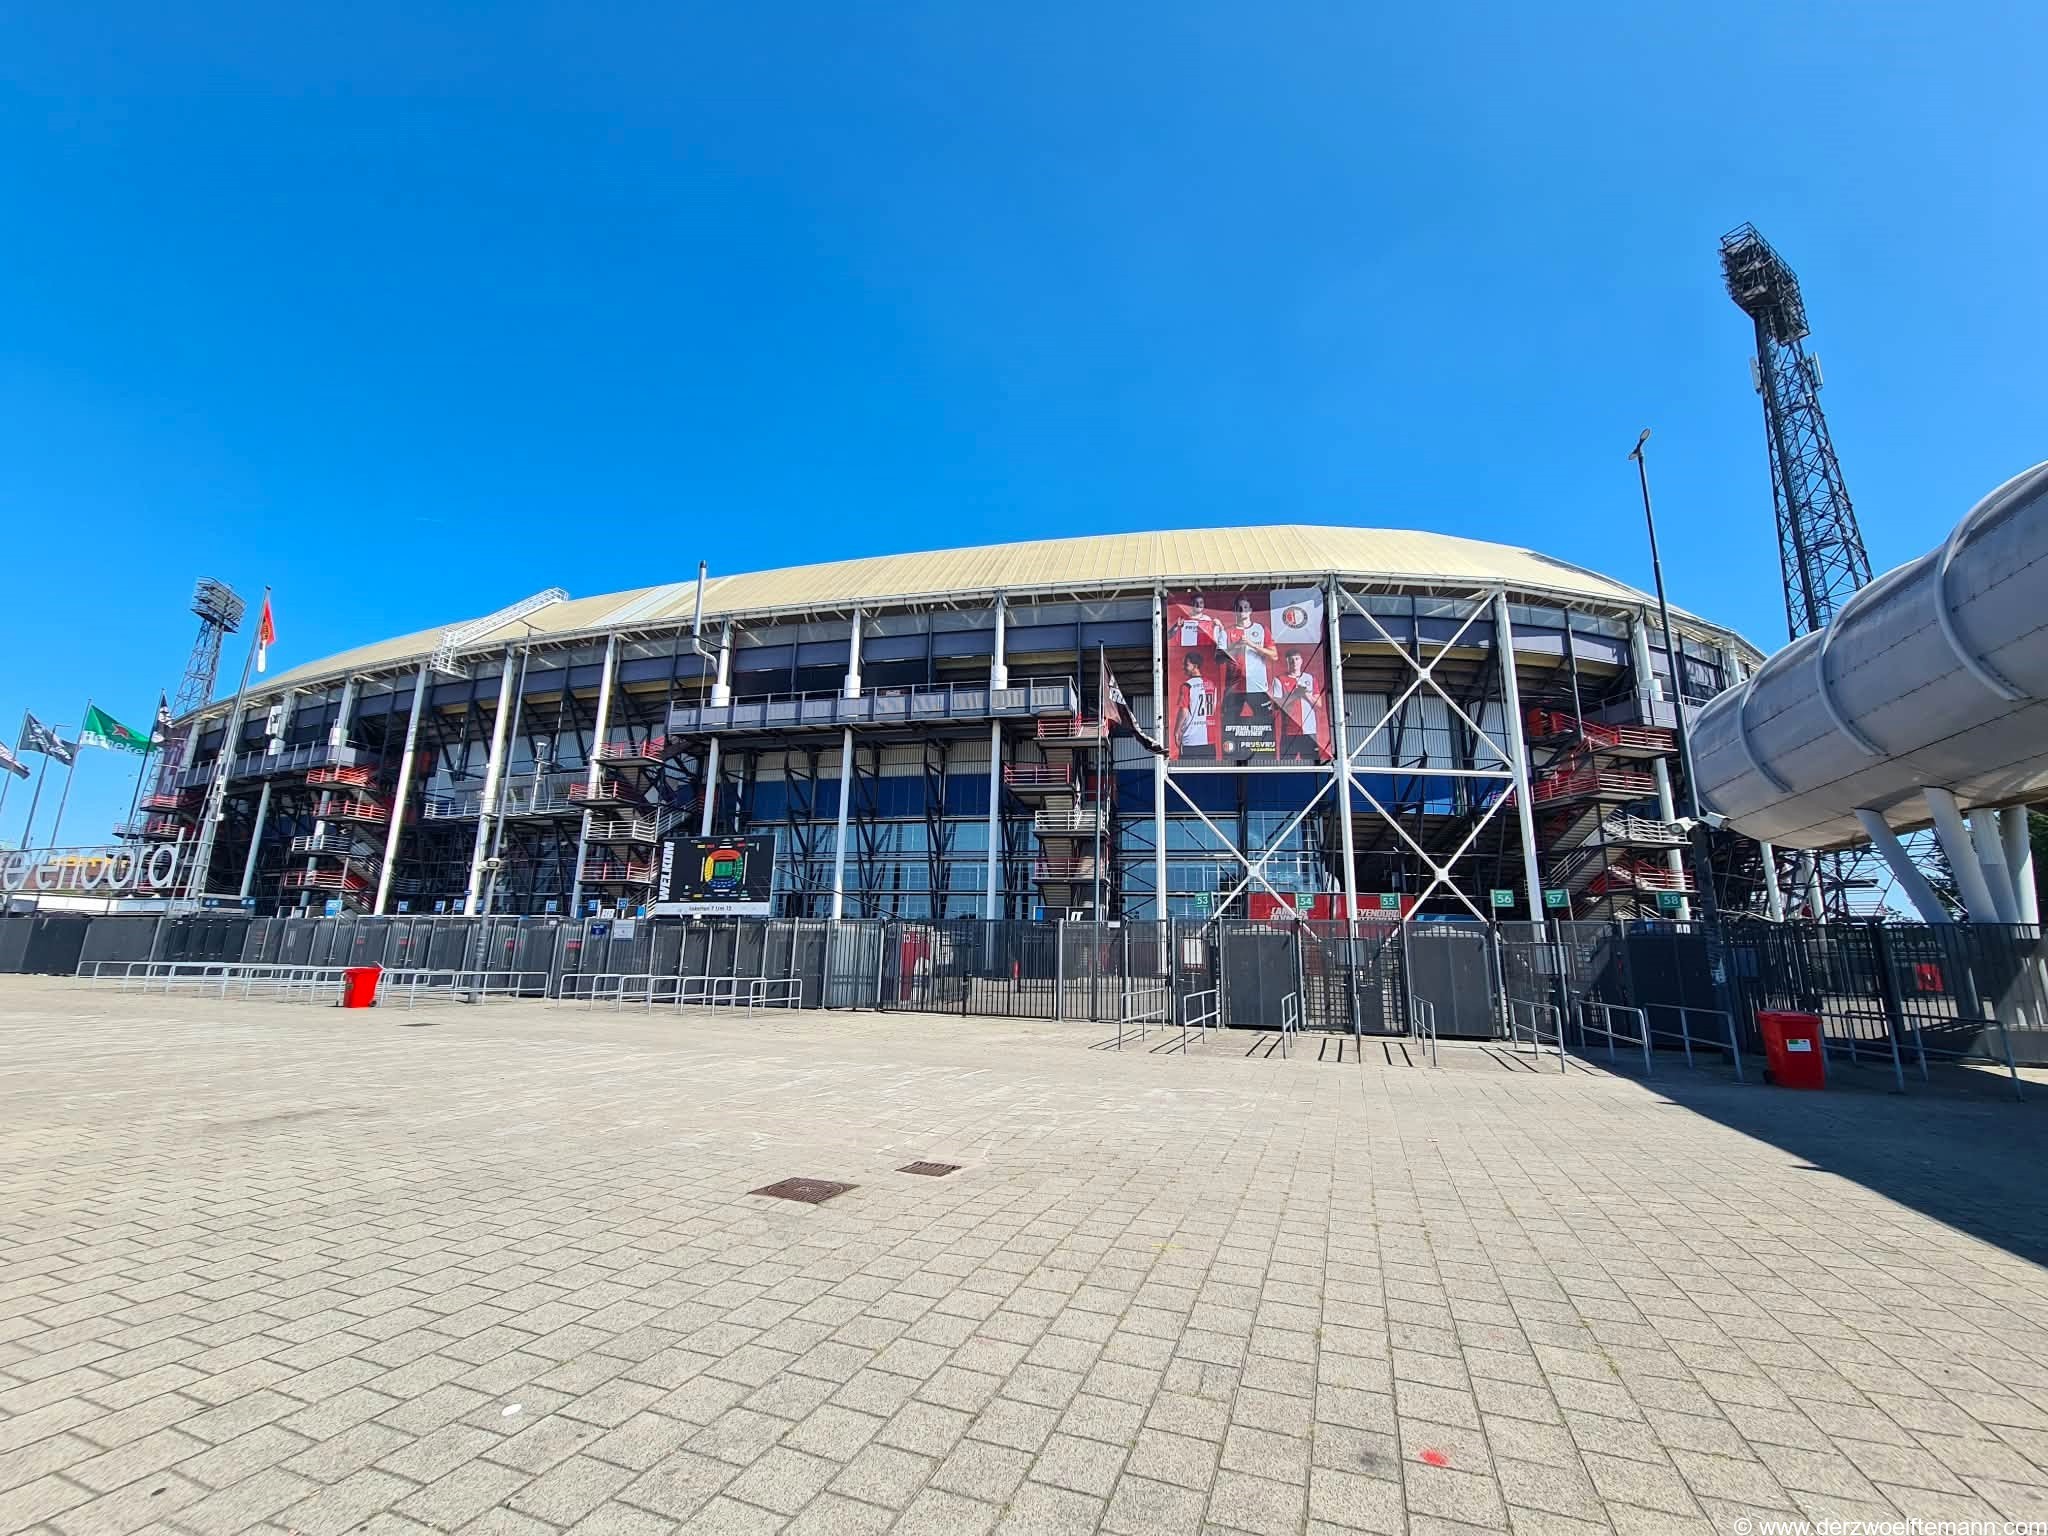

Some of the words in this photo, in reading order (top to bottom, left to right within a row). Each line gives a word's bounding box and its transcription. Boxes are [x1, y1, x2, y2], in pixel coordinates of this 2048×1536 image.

[0, 827, 185, 890] eyenoord
[1197, 896, 1209, 905] 53
[1300, 896, 1312, 905] 54
[1383, 896, 1395, 905] 55
[1496, 895, 1511, 904] 56
[1549, 895, 1562, 904] 57
[1663, 896, 1678, 905] 58
